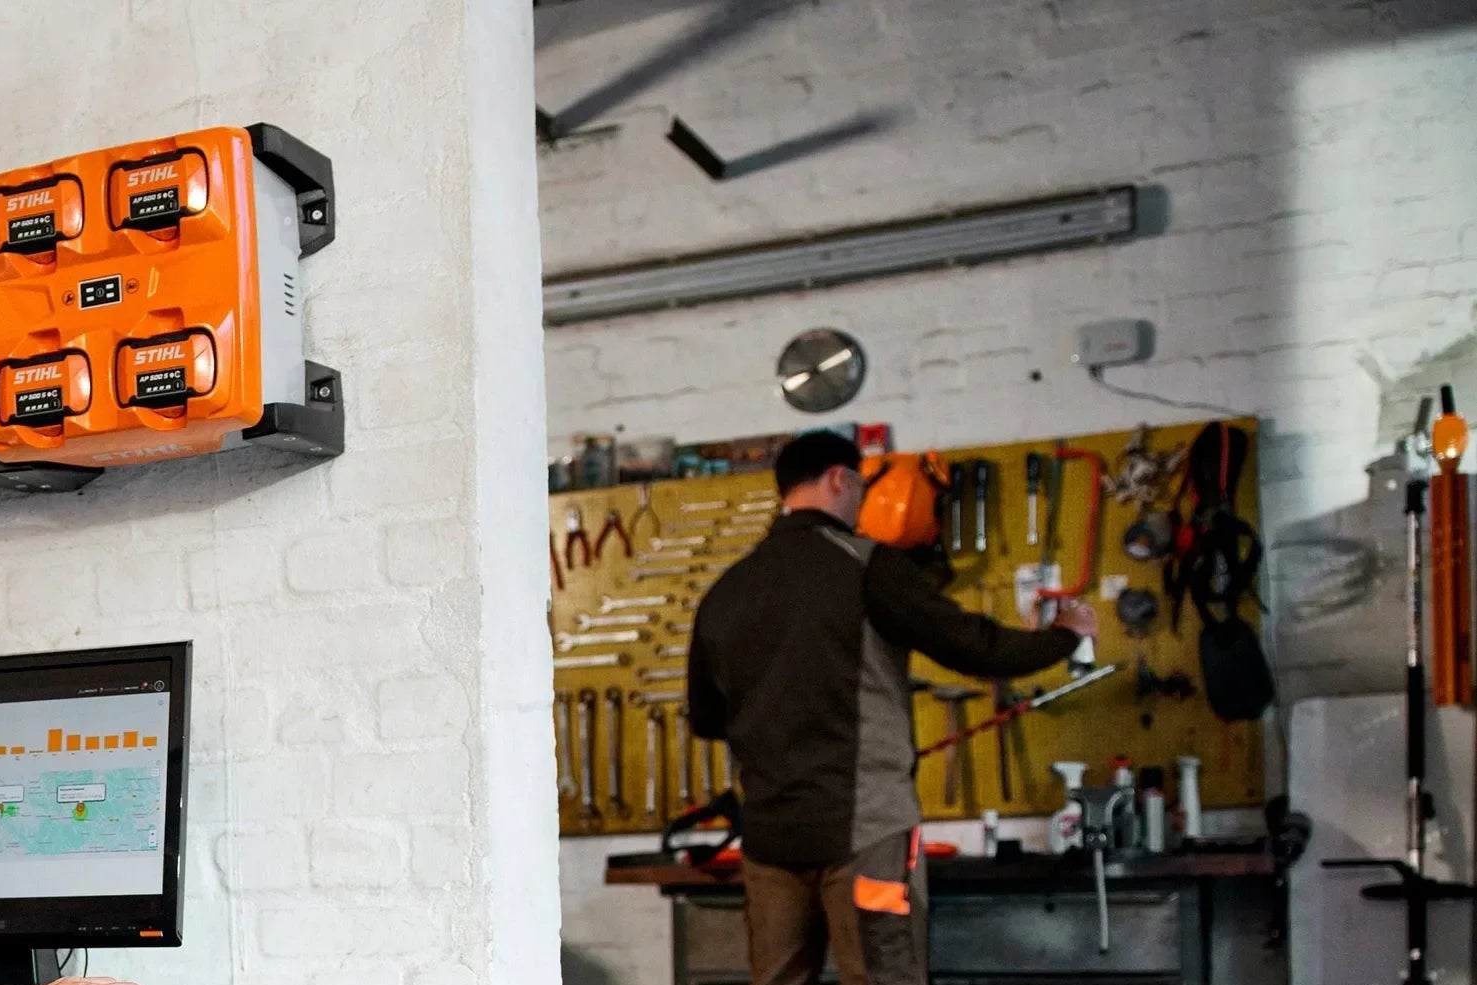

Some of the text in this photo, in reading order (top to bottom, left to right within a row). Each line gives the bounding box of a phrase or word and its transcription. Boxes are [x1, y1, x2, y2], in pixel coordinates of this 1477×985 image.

[127, 165, 178, 187] STIHL
[6, 191, 54, 212] STIHL
[134, 345, 185, 365] STIHL
[13, 365, 62, 385] STIHL
[139, 375, 150, 383] AP
[18, 394, 28, 402] AP
